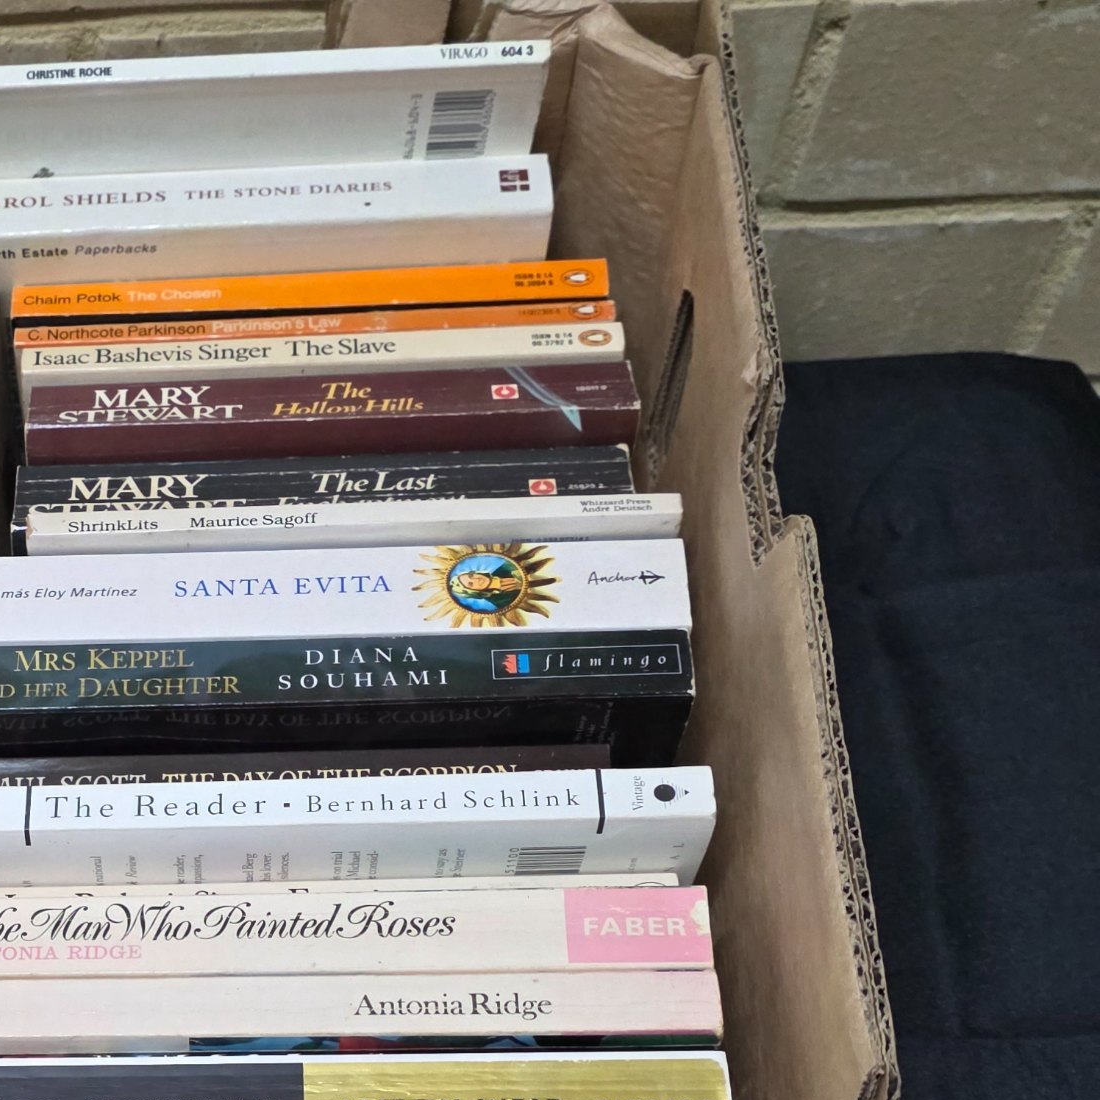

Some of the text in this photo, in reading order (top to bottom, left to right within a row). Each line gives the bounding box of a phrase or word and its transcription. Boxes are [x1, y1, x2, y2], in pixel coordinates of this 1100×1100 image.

[440, 47, 488, 59] VIRAGO
[26, 67, 112, 80] CHRISTINE ROCHE
[62, 190, 166, 206] SHIELDS
[184, 188, 226, 200] THE
[234, 184, 301, 199] STONE
[309, 180, 393, 195] DIARIES
[21, 242, 157, 259] Estate Paperbacks
[23, 288, 222, 306] Chaim Potok The Chosen
[34, 338, 397, 366] Isaac Bashevis Singer The Slave
[68, 512, 319, 533] ShrinkLits Maurice Sagoff
[174, 575, 393, 598] SANTA EVITA
[587, 571, 637, 586] Anchor
[34, 588, 66, 600] Eloy
[70, 586, 138, 598] Martínez
[13, 647, 195, 673] MRS KEPPEL
[304, 646, 419, 666] DIANA
[541, 652, 668, 673] flamingo
[23, 682, 69, 698] HER
[77, 675, 242, 699] DAUGHTER
[277, 668, 449, 691] SOUHAMI
[45, 787, 581, 819] The Reader Bernhard Schlink
[632, 775, 646, 811] Vintage
[582, 917, 686, 937] FABER
[67, 944, 142, 960] RIDGE
[353, 992, 553, 1020] Antonia Ridge
